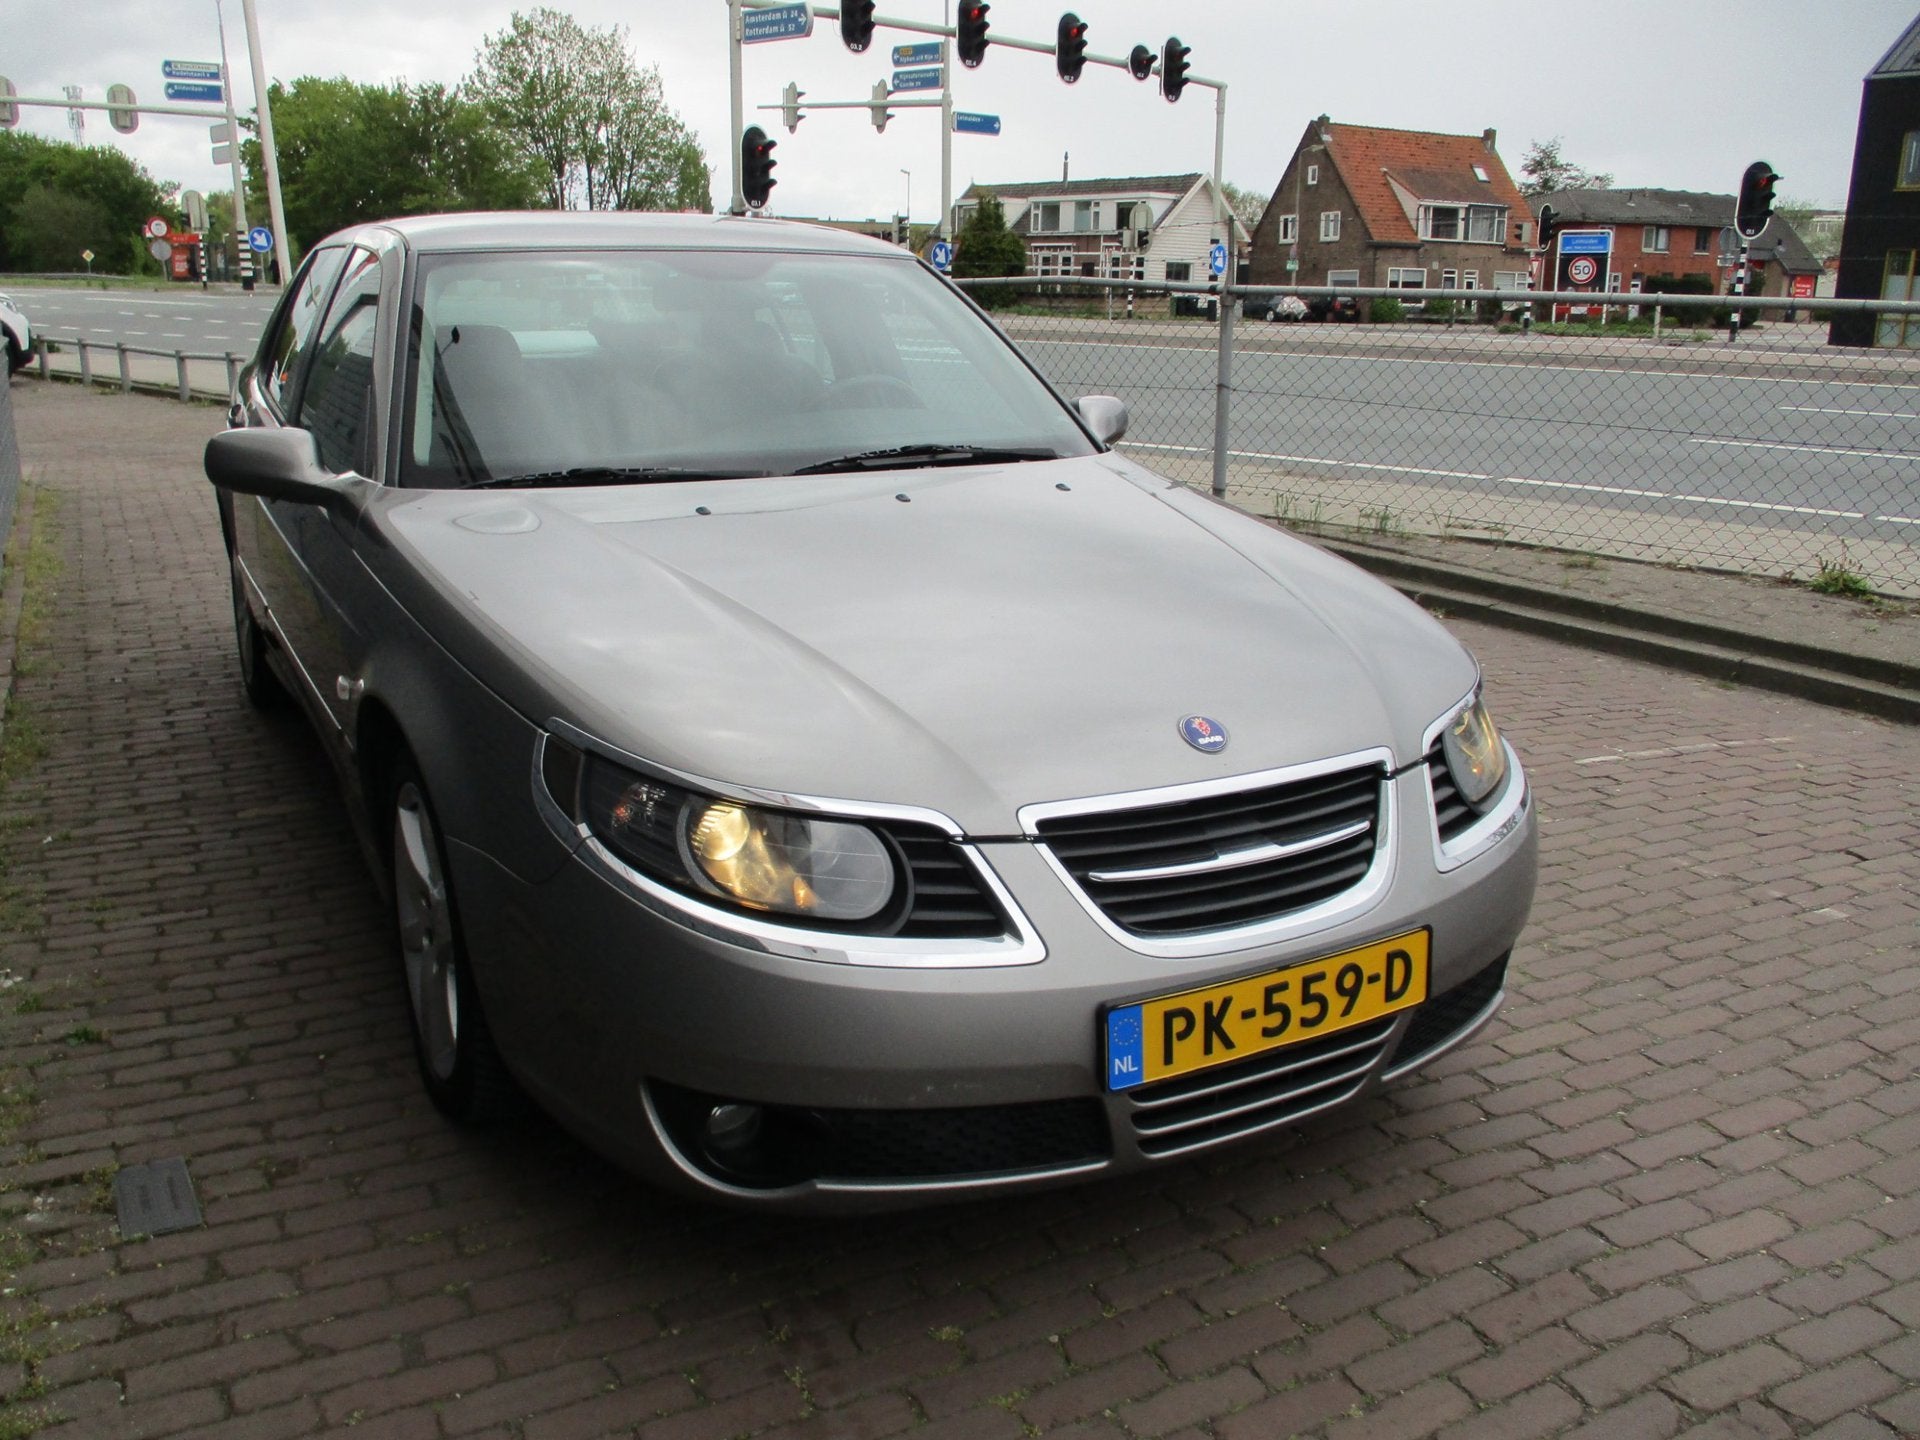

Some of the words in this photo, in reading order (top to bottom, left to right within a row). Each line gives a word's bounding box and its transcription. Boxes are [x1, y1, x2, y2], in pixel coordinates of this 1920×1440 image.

[745, 12, 781, 24] Amsterdam
[745, 25, 778, 36] Rotterdam
[1574, 265, 1590, 275] 50
[1163, 949, 1413, 1066] PK-559-D
[1114, 1056, 1138, 1075] NL
